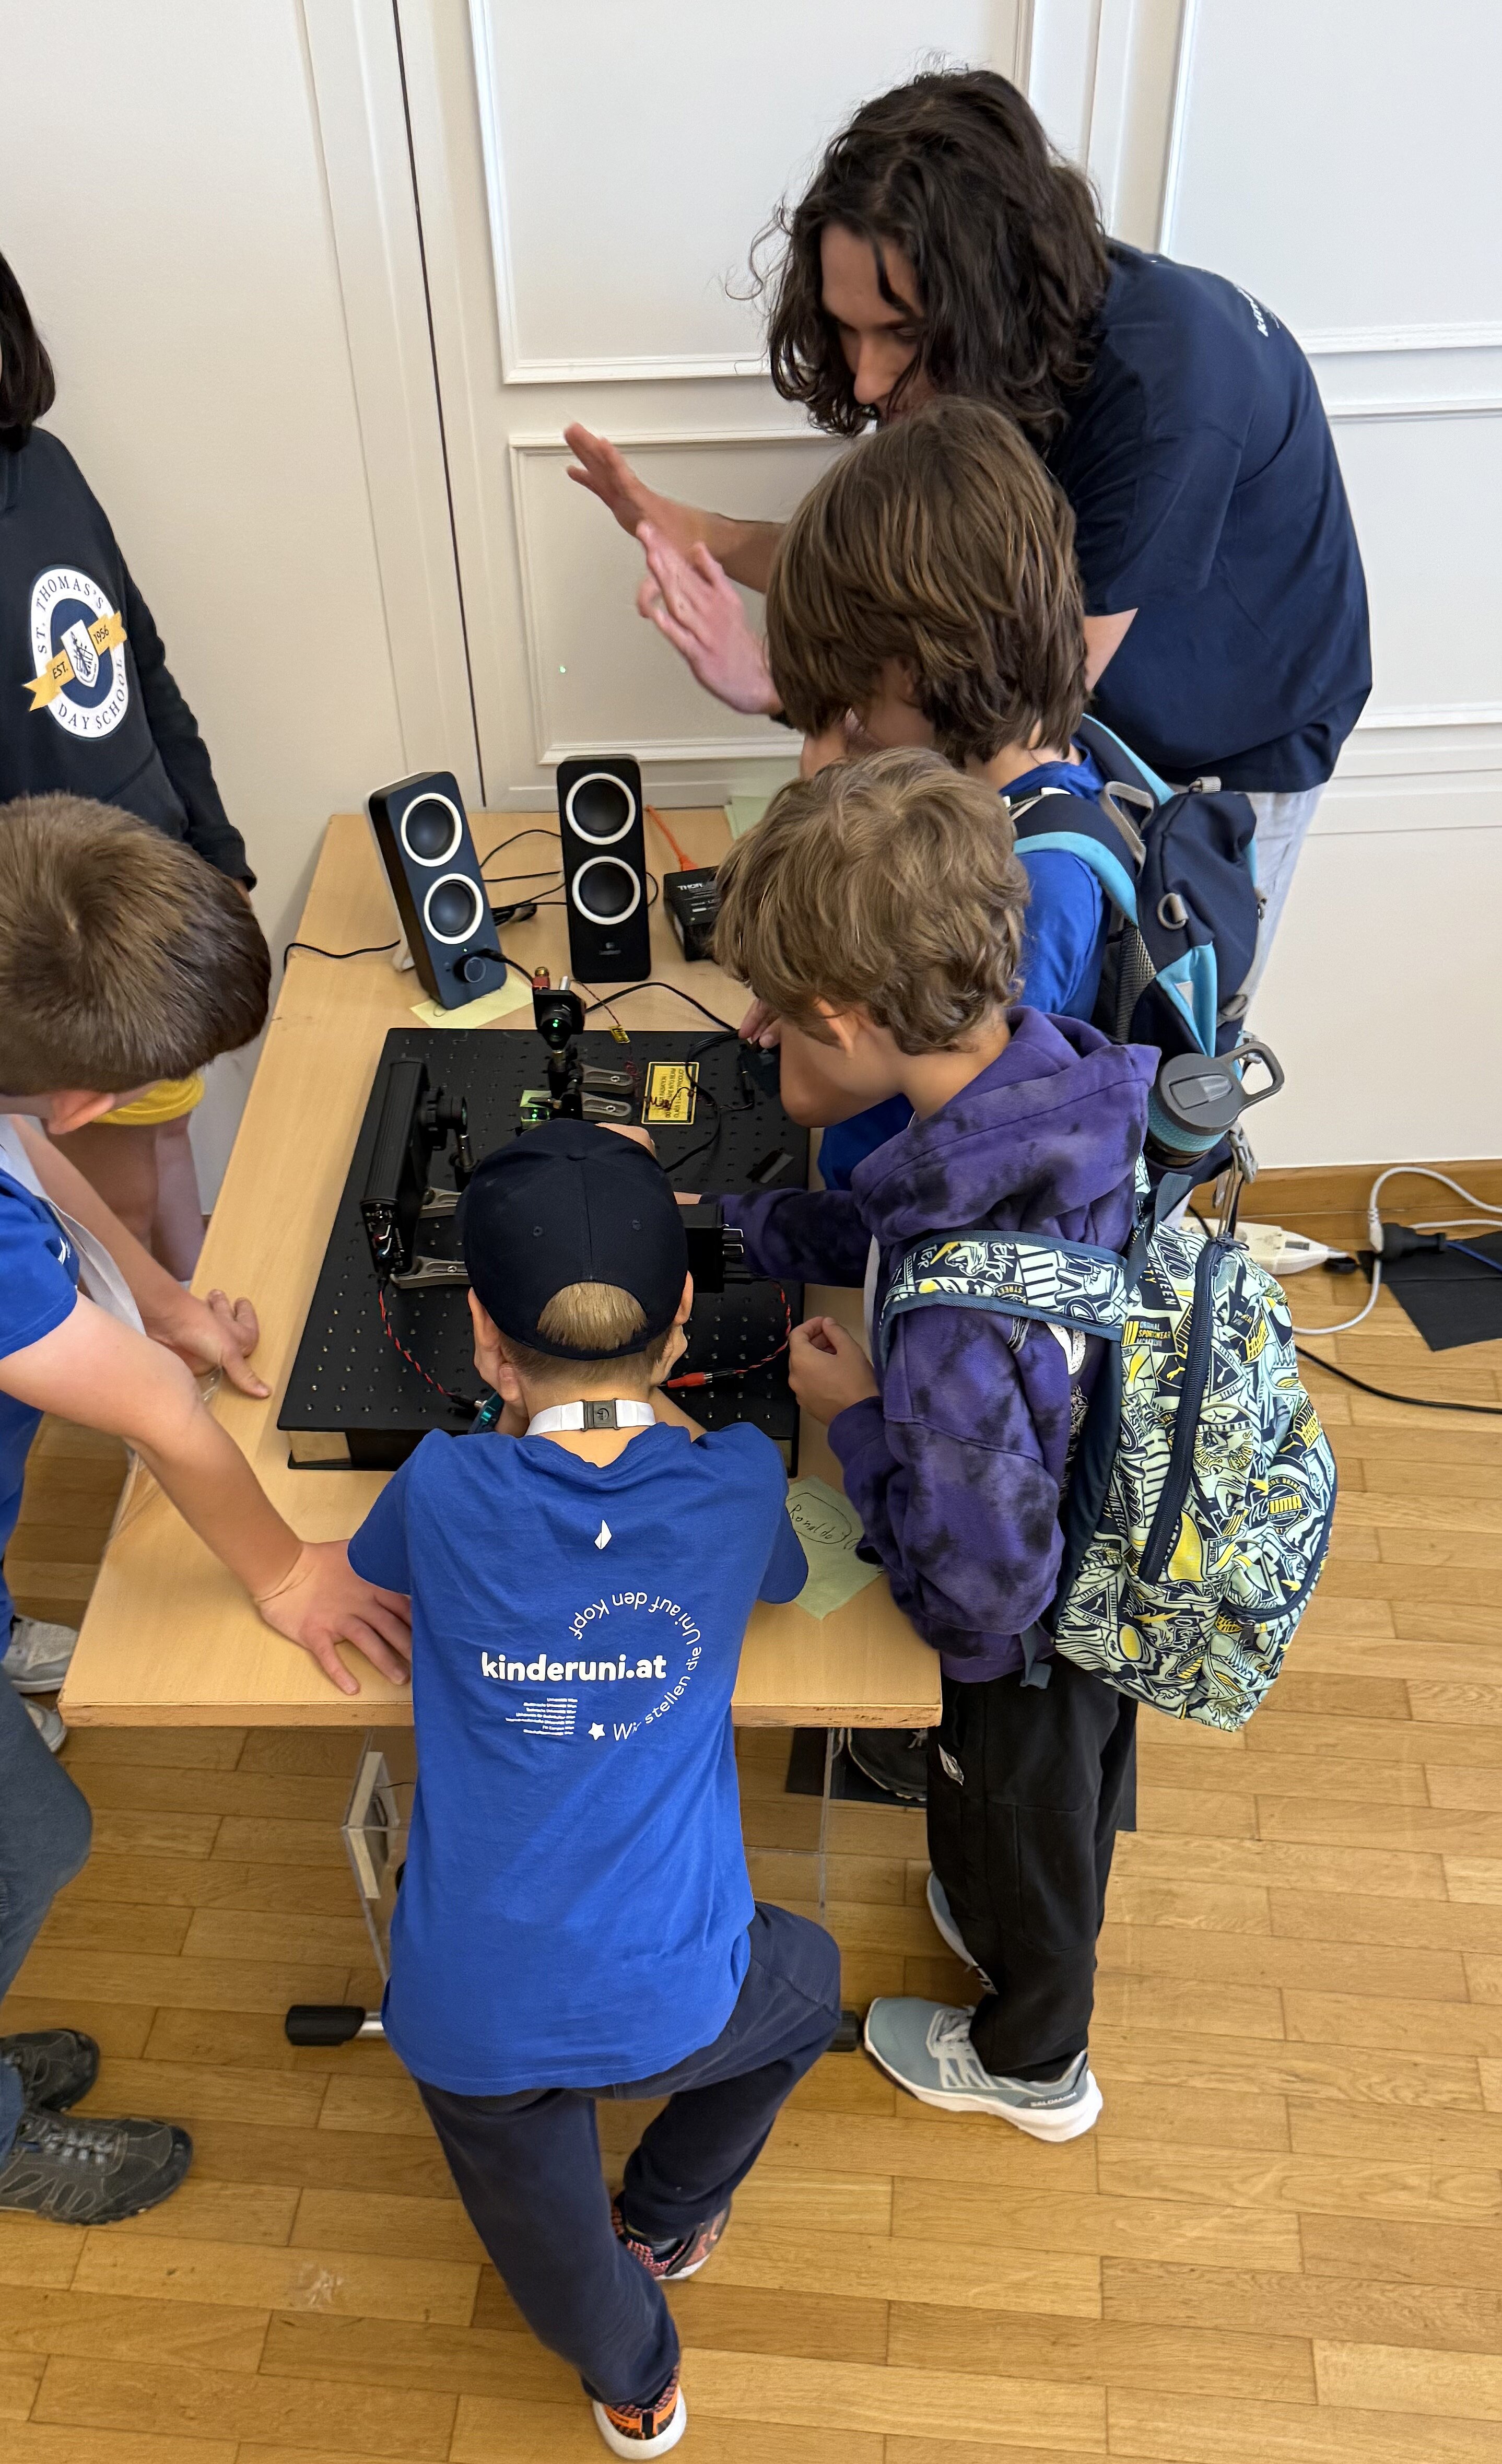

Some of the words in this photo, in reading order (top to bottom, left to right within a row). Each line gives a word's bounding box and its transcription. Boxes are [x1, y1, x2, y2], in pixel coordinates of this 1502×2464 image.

[36, 576, 103, 612] THOMAS'S
[93, 625, 109, 644] 1956
[52, 661, 68, 679] EST.
[58, 703, 90, 730] DAY
[96, 660, 125, 729] SCHOOL
[789, 1504, 834, 1540] Ronaldo
[612, 1591, 648, 1610] den
[648, 1595, 681, 1616] auf
[568, 1599, 610, 1640] Kopf
[674, 1612, 701, 1645] Uni
[482, 1651, 667, 1681] kinderuni.at
[685, 1646, 702, 1671] die
[644, 1675, 691, 1724] stellen
[613, 1721, 642, 1741] Wir
